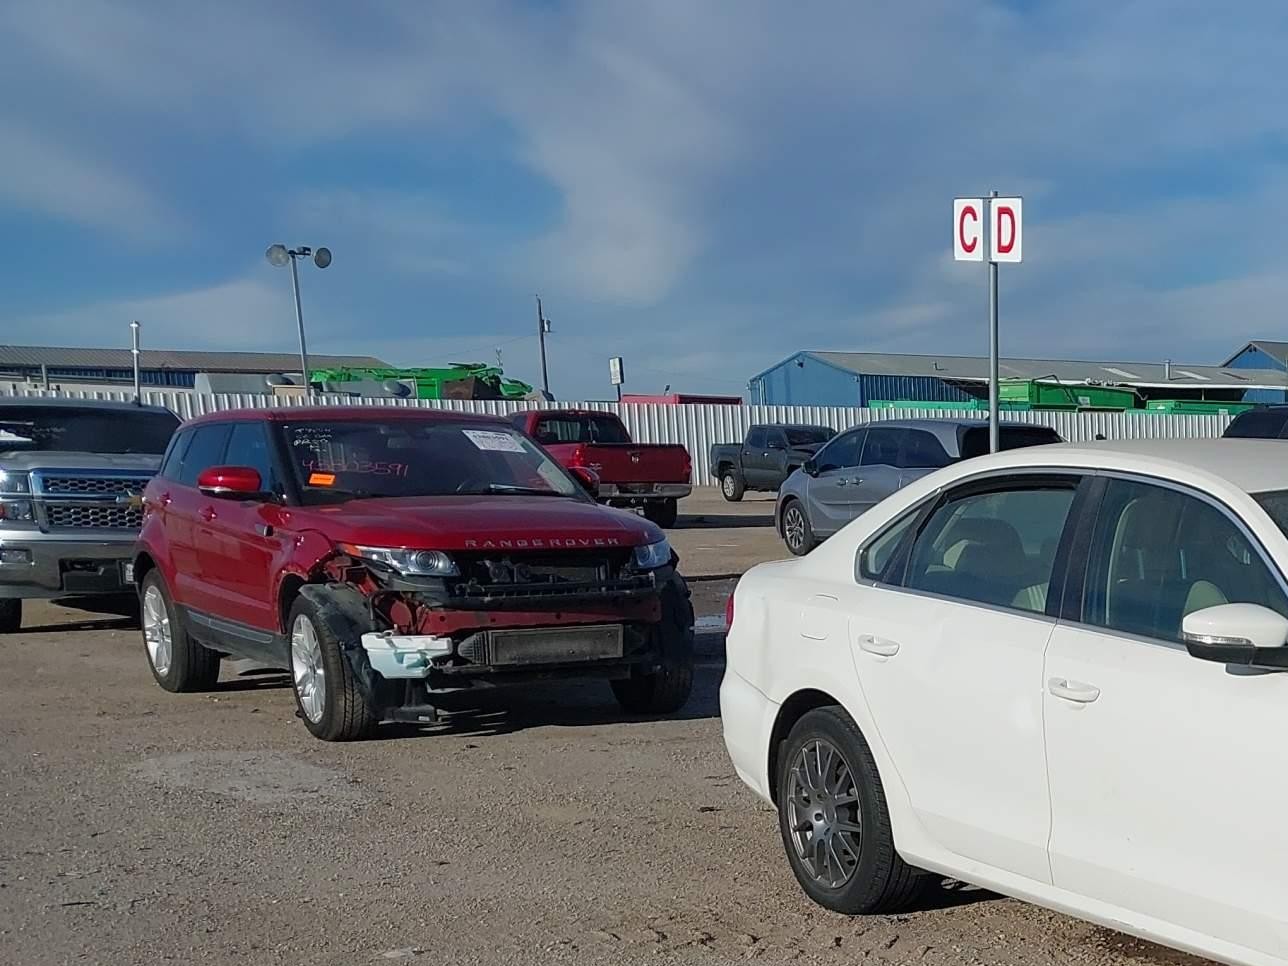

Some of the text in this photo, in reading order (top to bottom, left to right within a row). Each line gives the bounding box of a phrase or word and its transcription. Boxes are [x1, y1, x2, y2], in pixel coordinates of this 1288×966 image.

[959, 206, 977, 253] C
[997, 207, 1016, 254] D
[464, 538, 619, 548] RANGE ROVER
